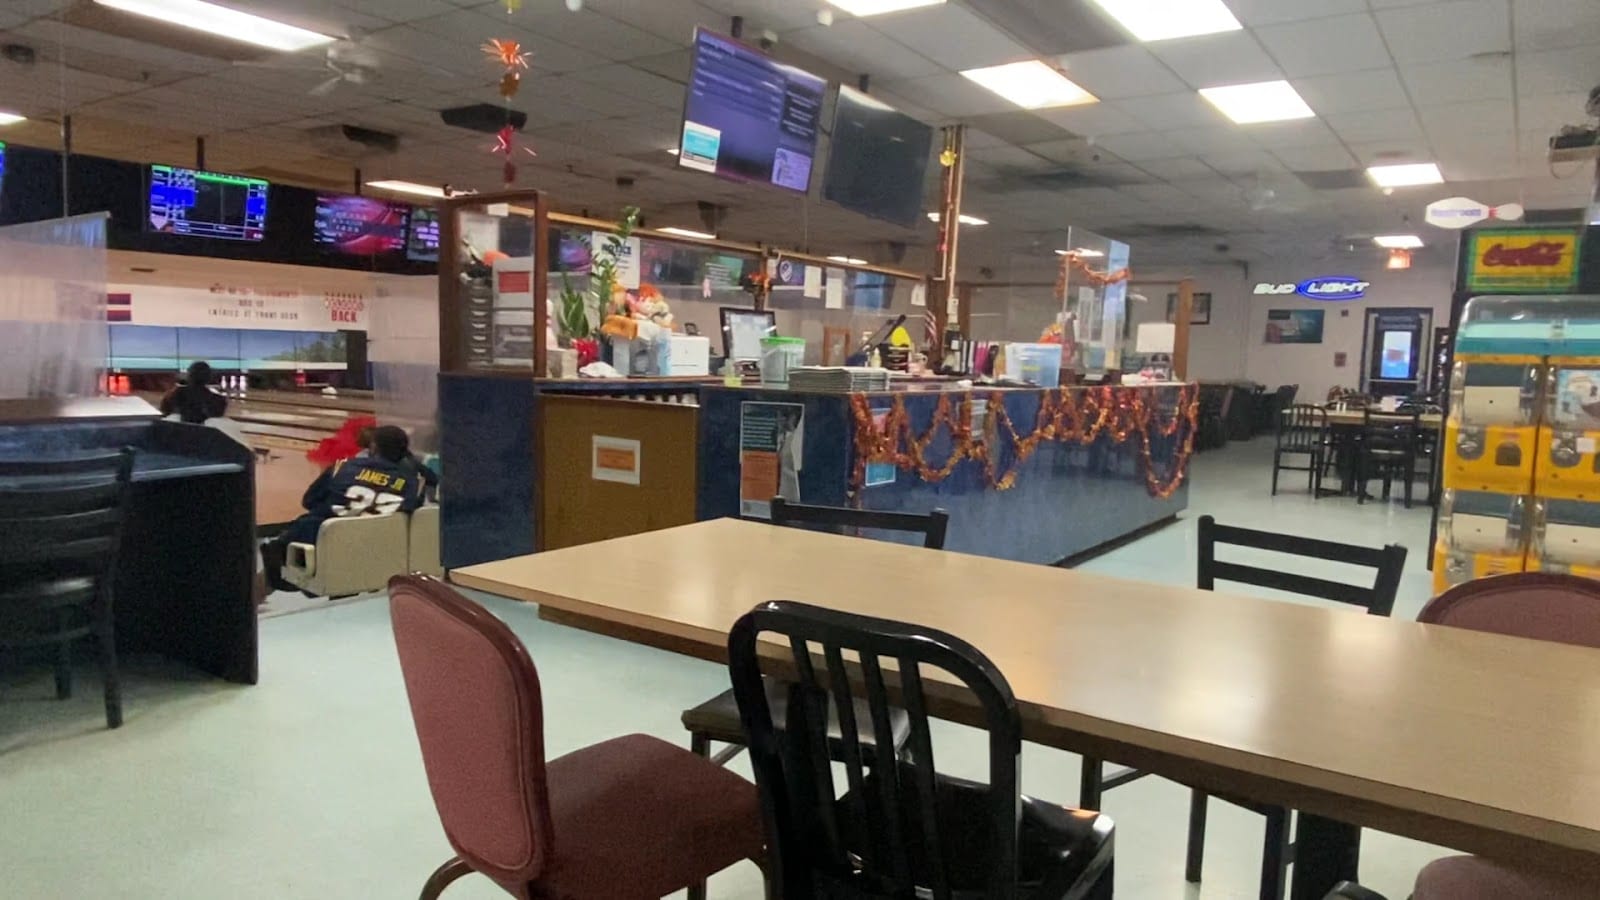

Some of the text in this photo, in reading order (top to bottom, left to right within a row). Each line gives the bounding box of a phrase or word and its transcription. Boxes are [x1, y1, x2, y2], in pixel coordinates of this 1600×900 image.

[1253, 282, 1371, 295] BUD LIGHT
[331, 310, 357, 322] BACK
[355, 468, 391, 487] JAMES
